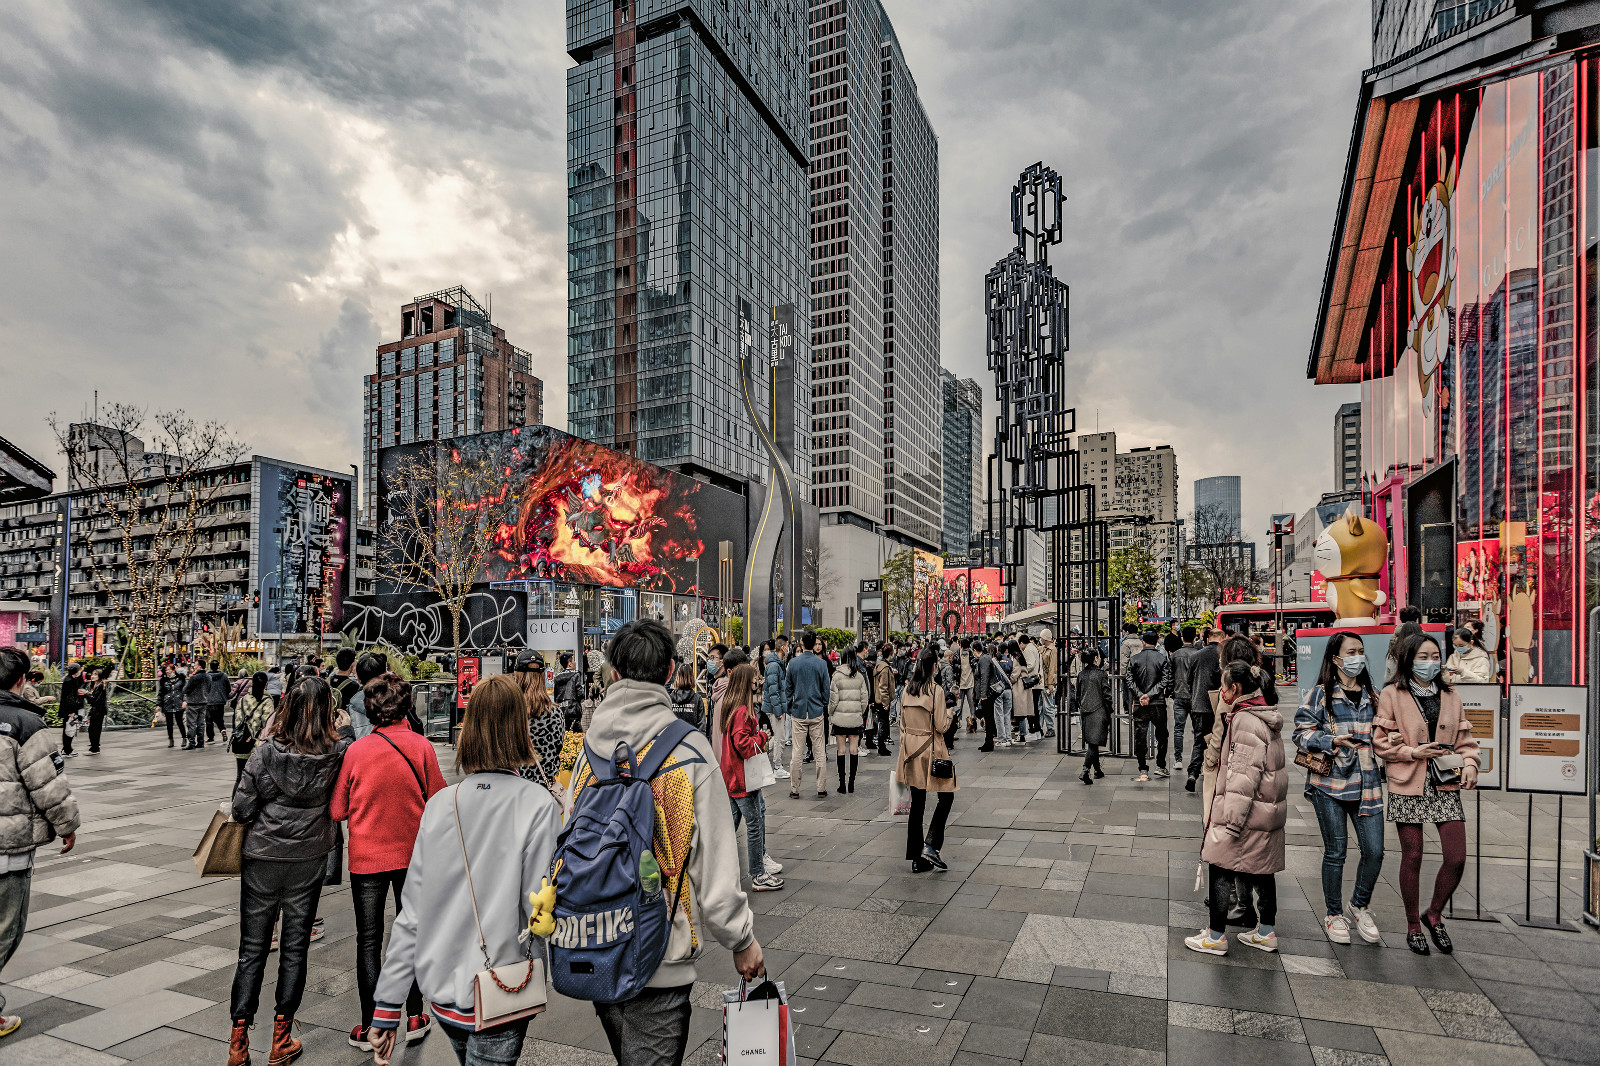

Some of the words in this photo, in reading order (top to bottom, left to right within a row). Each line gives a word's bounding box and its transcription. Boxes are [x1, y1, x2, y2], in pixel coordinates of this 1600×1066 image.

[1483, 217, 1532, 288] GUCCI
[779, 323, 788, 336] TAI
[770, 325, 779, 362] 太古里
[529, 621, 575, 634] GUCCI
[740, 1048, 767, 1056] CHANEL
